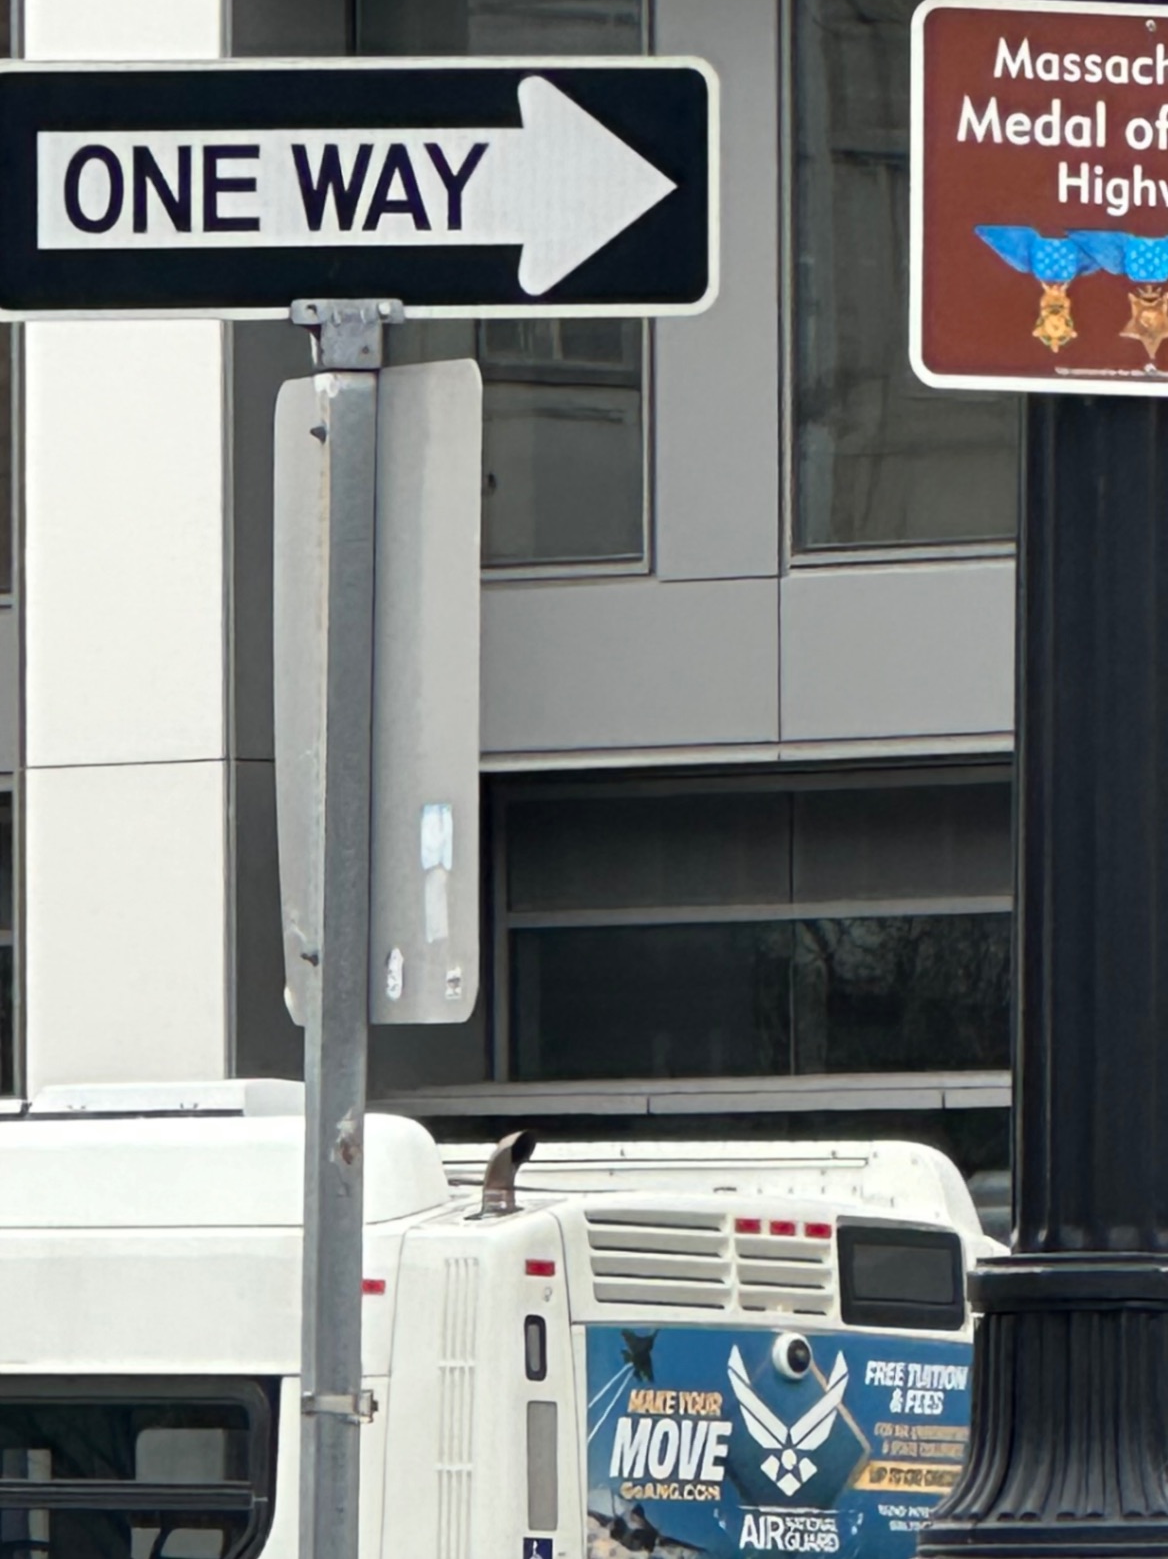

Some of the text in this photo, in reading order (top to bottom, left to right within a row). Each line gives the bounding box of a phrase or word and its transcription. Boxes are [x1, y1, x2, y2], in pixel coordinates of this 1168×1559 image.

[957, 95, 1107, 148] Medal
[63, 142, 490, 234] ONE WAY
[865, 1361, 969, 1390] FREE TUITION
[627, 1389, 723, 1416] MAKE YOUR
[905, 1390, 945, 1415] FEES
[609, 1417, 733, 1481] MOVE
[739, 1513, 785, 1550] AIR
